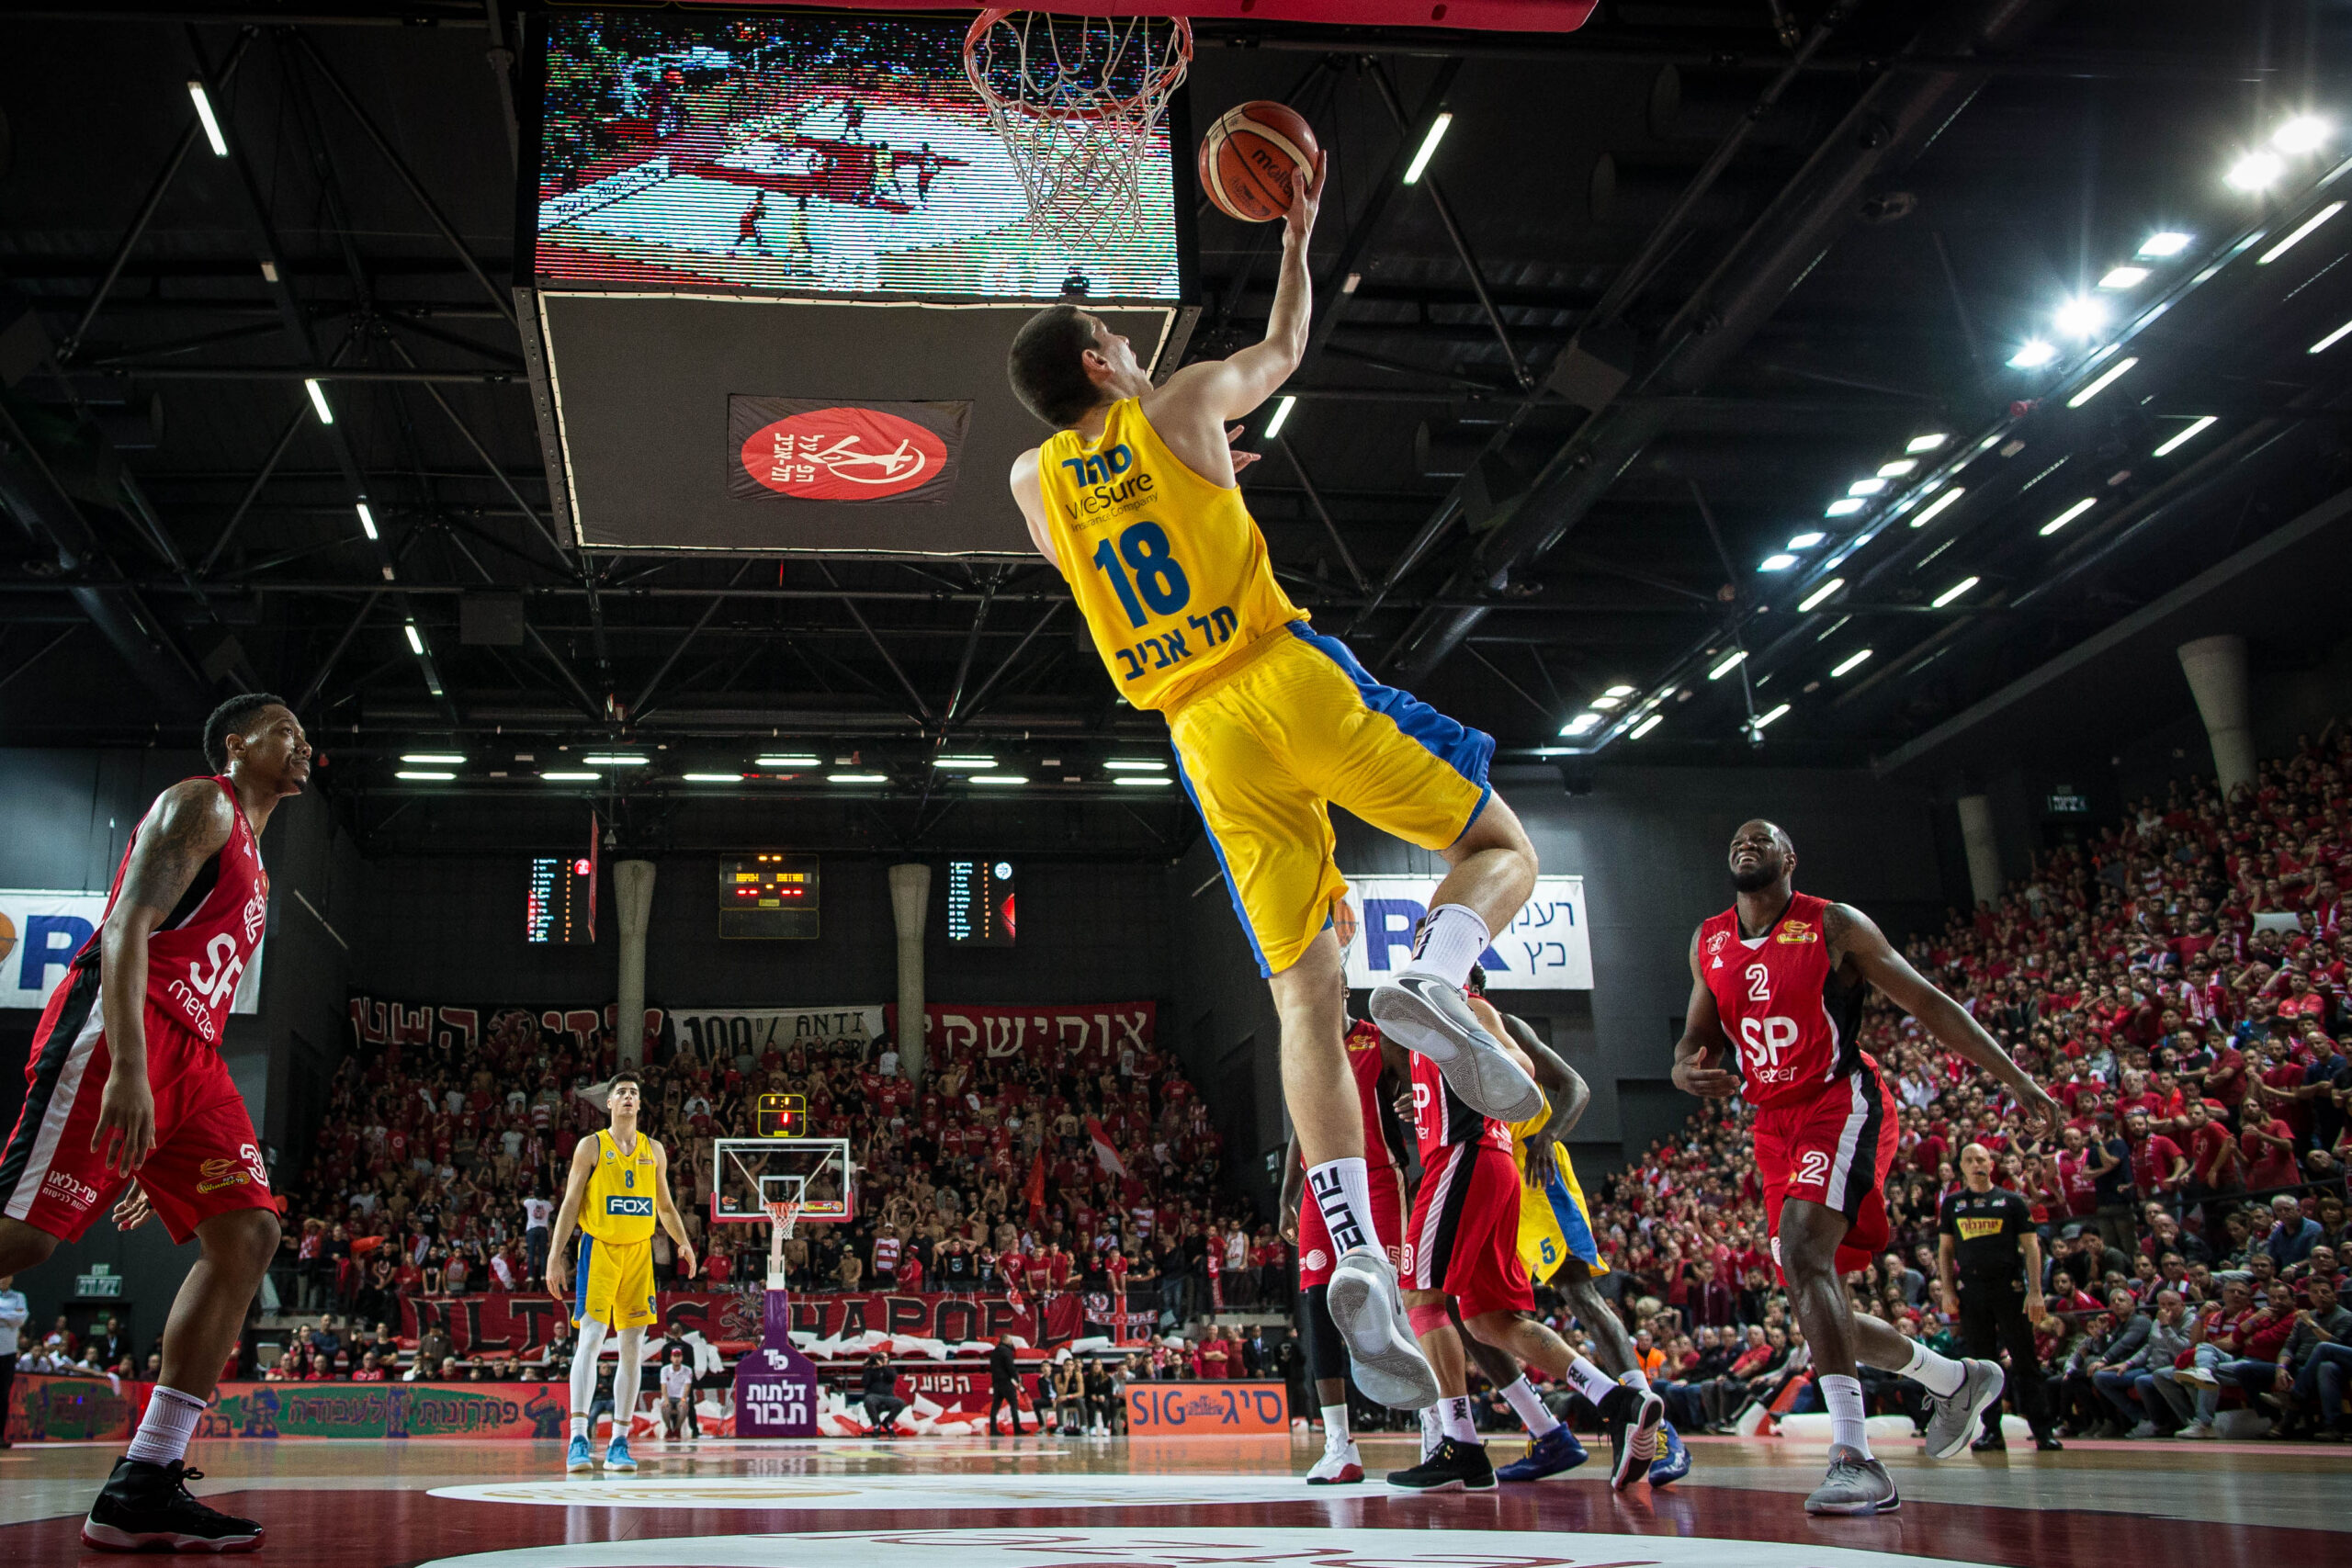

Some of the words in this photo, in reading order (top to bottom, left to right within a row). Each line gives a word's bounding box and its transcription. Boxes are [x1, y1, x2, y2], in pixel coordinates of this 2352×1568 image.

[1110, 491, 1159, 517] Company
[1092, 521, 1191, 629] 18
[1187, 605, 1238, 647] תל
[1115, 628, 1193, 681] אביב
[1523, 942, 1566, 976] כץ
[1746, 964, 1770, 1001] 2
[796, 1012, 864, 1037] ANTI
[924, 1010, 1148, 1058] אוסישקי
[1740, 1016, 1799, 1066] SP
[625, 1169, 635, 1189] 8
[1797, 1151, 1829, 1187] 2
[610, 1199, 650, 1213] FOX
[1403, 1244, 1414, 1275] 8
[1540, 1236, 1556, 1265] 5
[648, 1295, 657, 1314] 8
[746, 1380, 807, 1402] דלתות
[904, 1374, 971, 1394] הפועל
[288, 1393, 389, 1425] לעבודה
[418, 1400, 520, 1426] פתרונות
[746, 1403, 808, 1425] תבור
[1132, 1390, 1186, 1426] SIG
[1221, 1390, 1283, 1426] סיג
